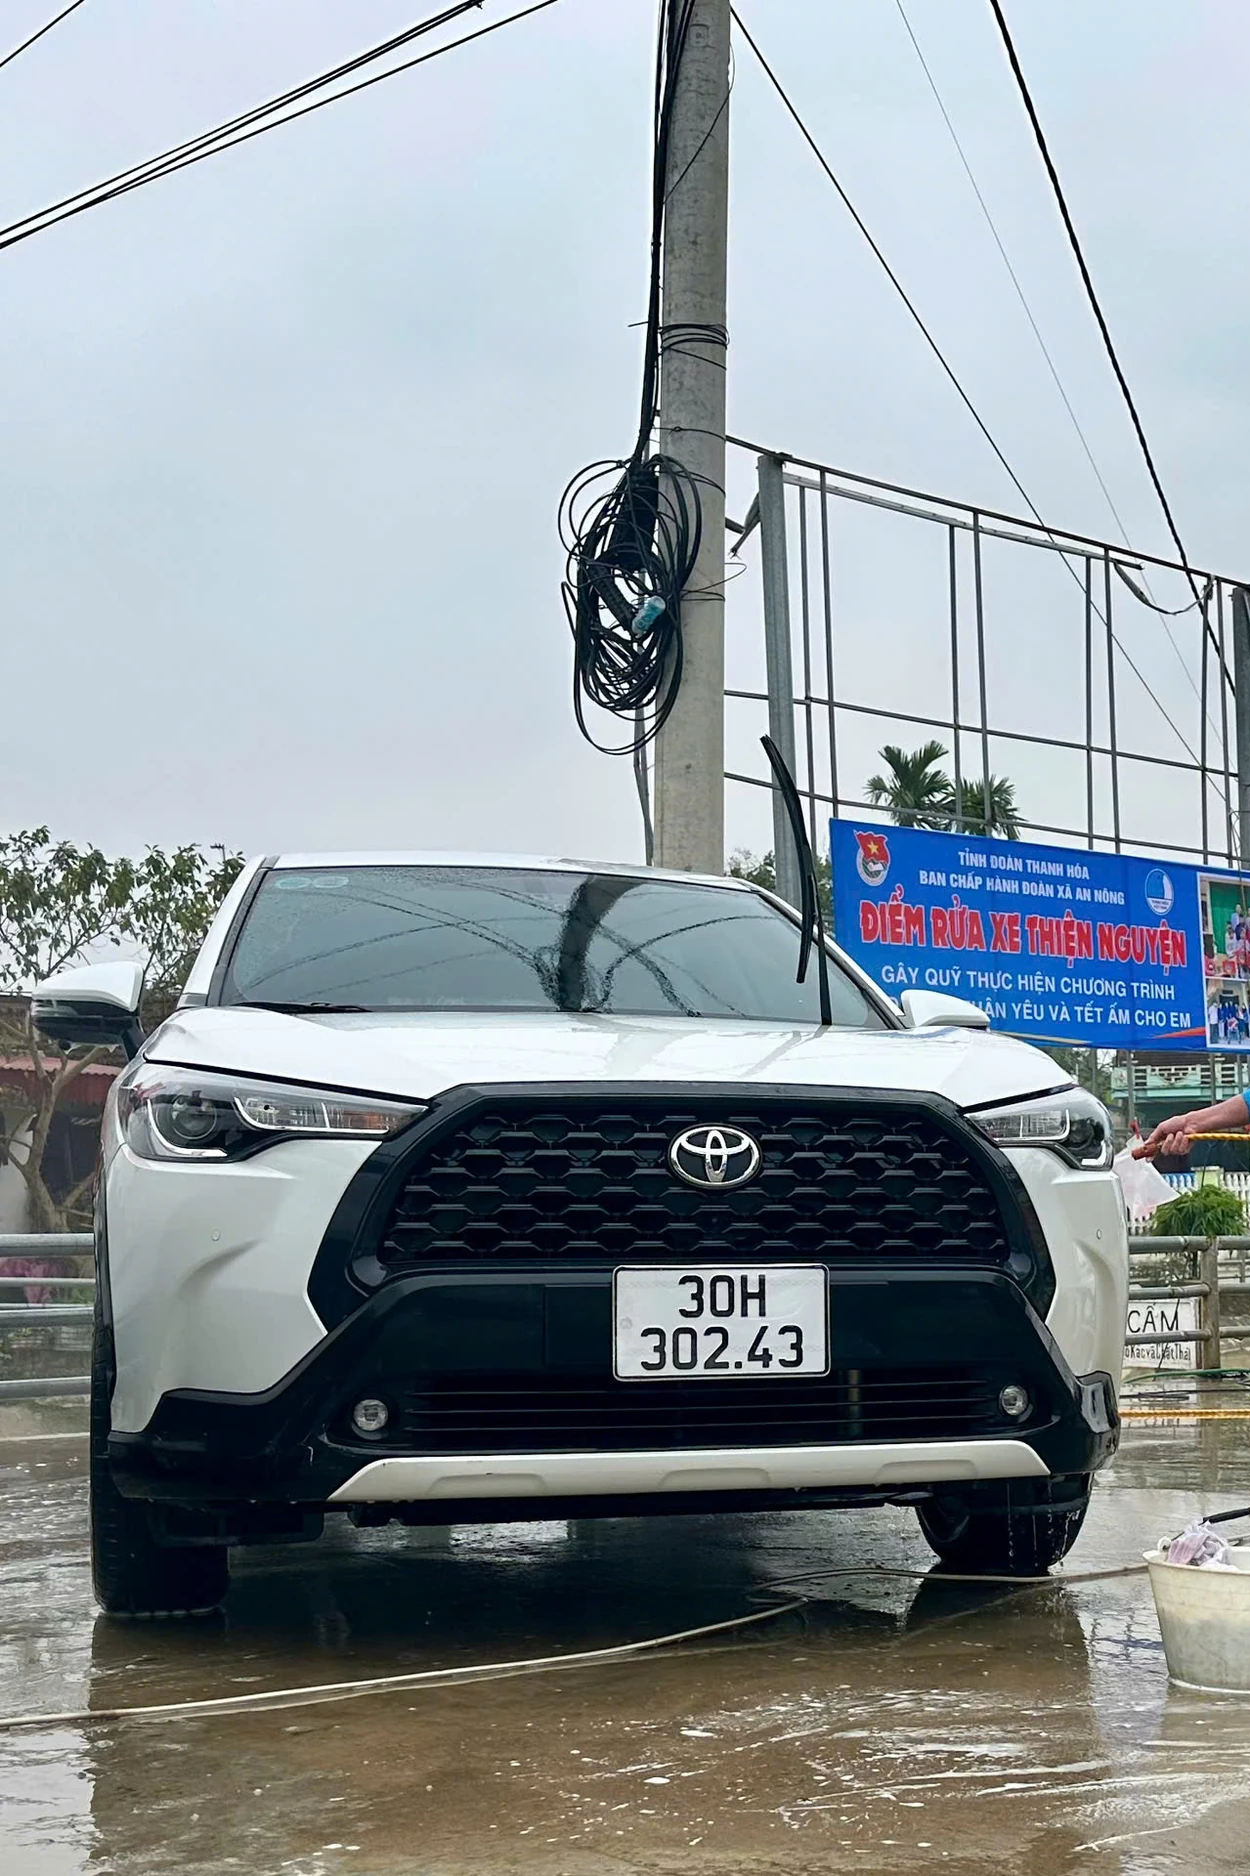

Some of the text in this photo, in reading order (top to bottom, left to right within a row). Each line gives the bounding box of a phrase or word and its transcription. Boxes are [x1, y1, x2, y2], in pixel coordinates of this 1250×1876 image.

[958, 847, 1090, 880] TỈNH ĐOÀN THANH HÓA
[919, 870, 1125, 905] BAN CHẤP HÀNH ĐOÀN XÃ AN NÔNG
[859, 883, 1187, 976] ĐIỂM RỬA XE THIỆN NGUYỆN
[881, 962, 1175, 1000] GÂY QUỸ THỰC HIỆN CHƯƠNG TRÌNH
[1011, 999, 1045, 1021] YÊU
[1049, 1001, 1071, 1022] VÀ
[1074, 1000, 1103, 1023] TẾT
[1107, 1002, 1130, 1025] ẤM
[1134, 1010, 1167, 1028] CHO
[1170, 1012, 1191, 1028] EM
[678, 1273, 767, 1318] 30H
[1127, 1302, 1179, 1333] CẤM
[640, 1325, 803, 1372] 302.43
